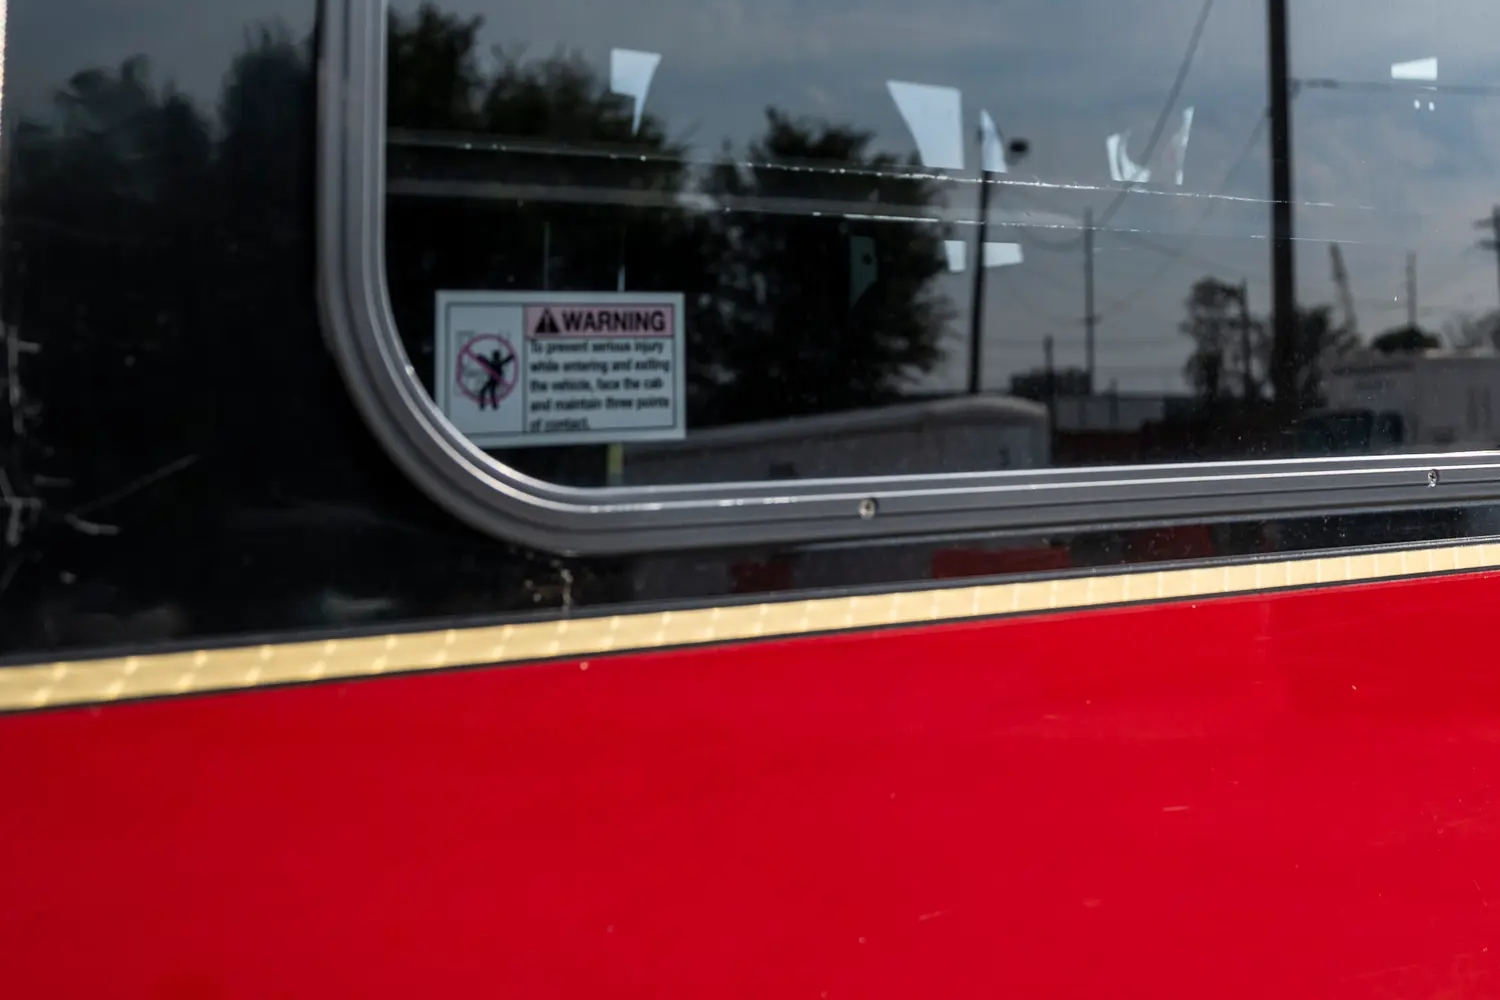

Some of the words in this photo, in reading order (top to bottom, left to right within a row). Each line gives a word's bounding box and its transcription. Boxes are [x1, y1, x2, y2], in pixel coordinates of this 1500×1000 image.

[561, 309, 666, 332] WARNING
[530, 340, 542, 352] To
[546, 340, 588, 354] prevent
[592, 341, 631, 352] serious
[635, 340, 664, 354] injury
[530, 361, 559, 372] while
[563, 360, 608, 374] entering
[612, 359, 631, 371] and
[635, 358, 670, 372] exiting
[530, 379, 548, 391] the
[597, 377, 620, 390] face
[623, 377, 640, 389] the
[644, 377, 664, 389] cab
[530, 400, 550, 412] and
[555, 398, 601, 411] maintain
[605, 397, 633, 409] three
[636, 396, 670, 410] points
[530, 417, 542, 430] of
